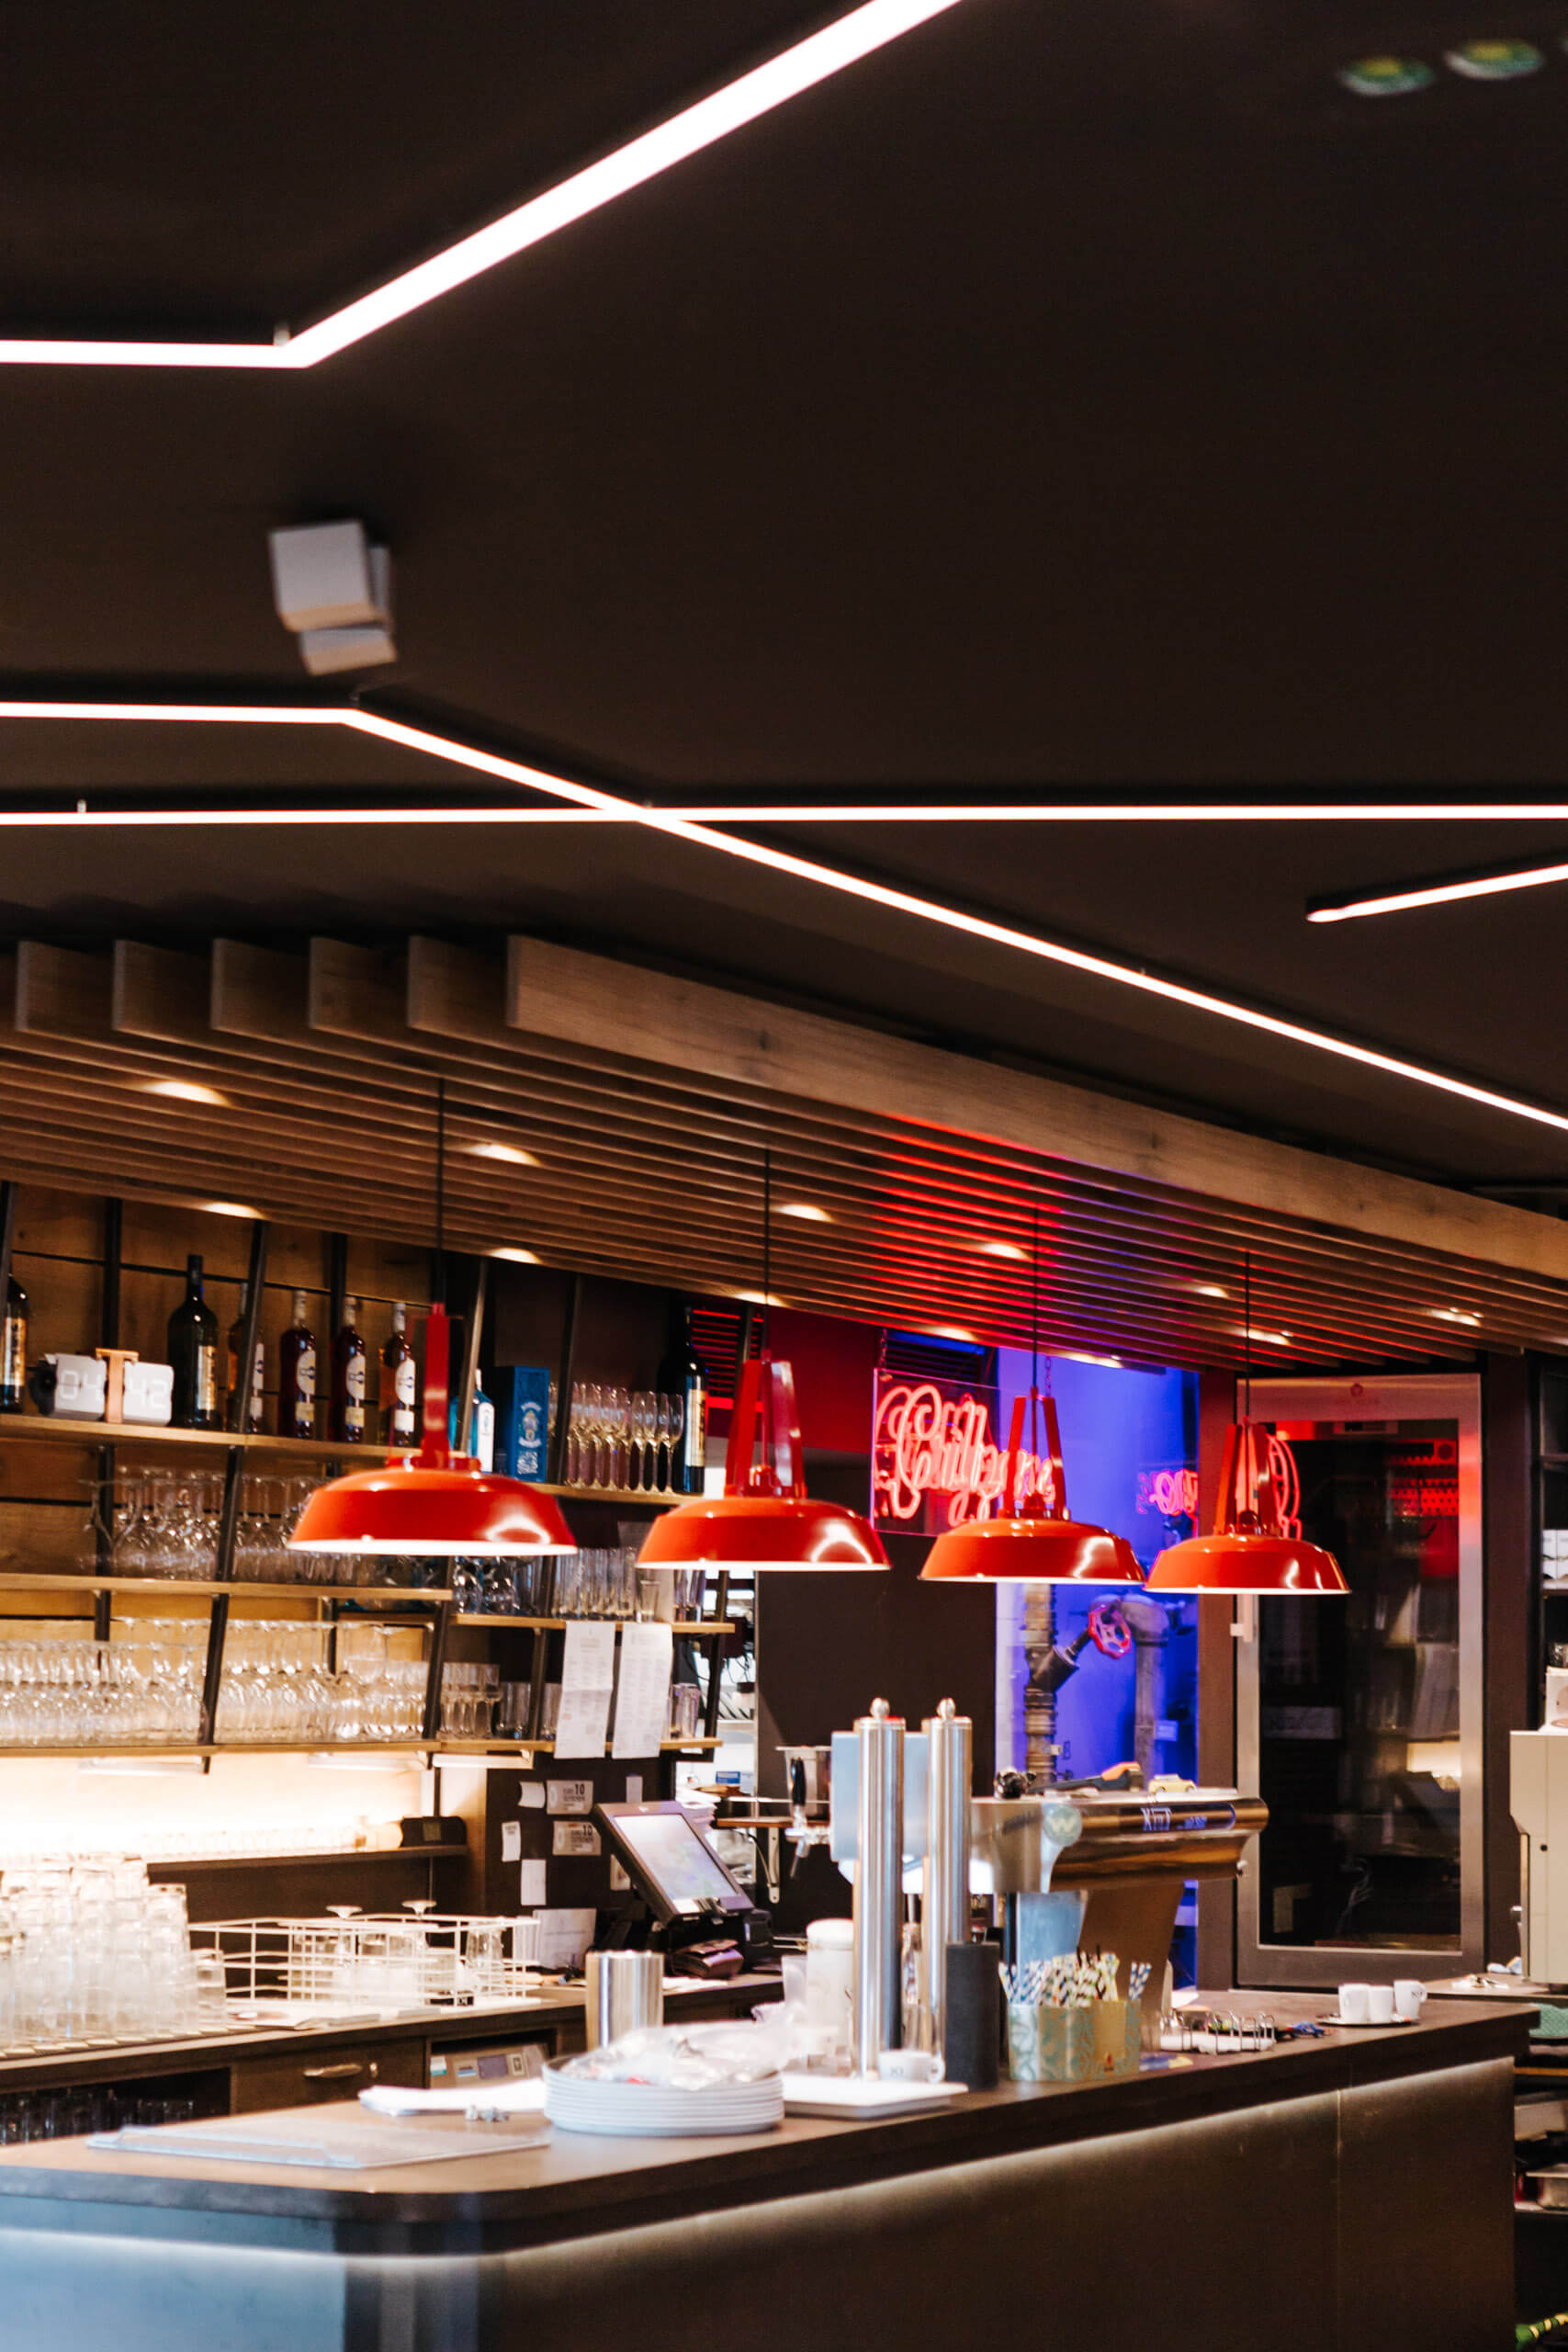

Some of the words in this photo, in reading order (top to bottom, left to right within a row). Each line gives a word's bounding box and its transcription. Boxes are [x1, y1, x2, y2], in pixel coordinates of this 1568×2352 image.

[60, 1369, 104, 1404] 04
[127, 1374, 169, 1409] 42
[574, 1783, 585, 1795] 10
[582, 1824, 593, 1837] 10
